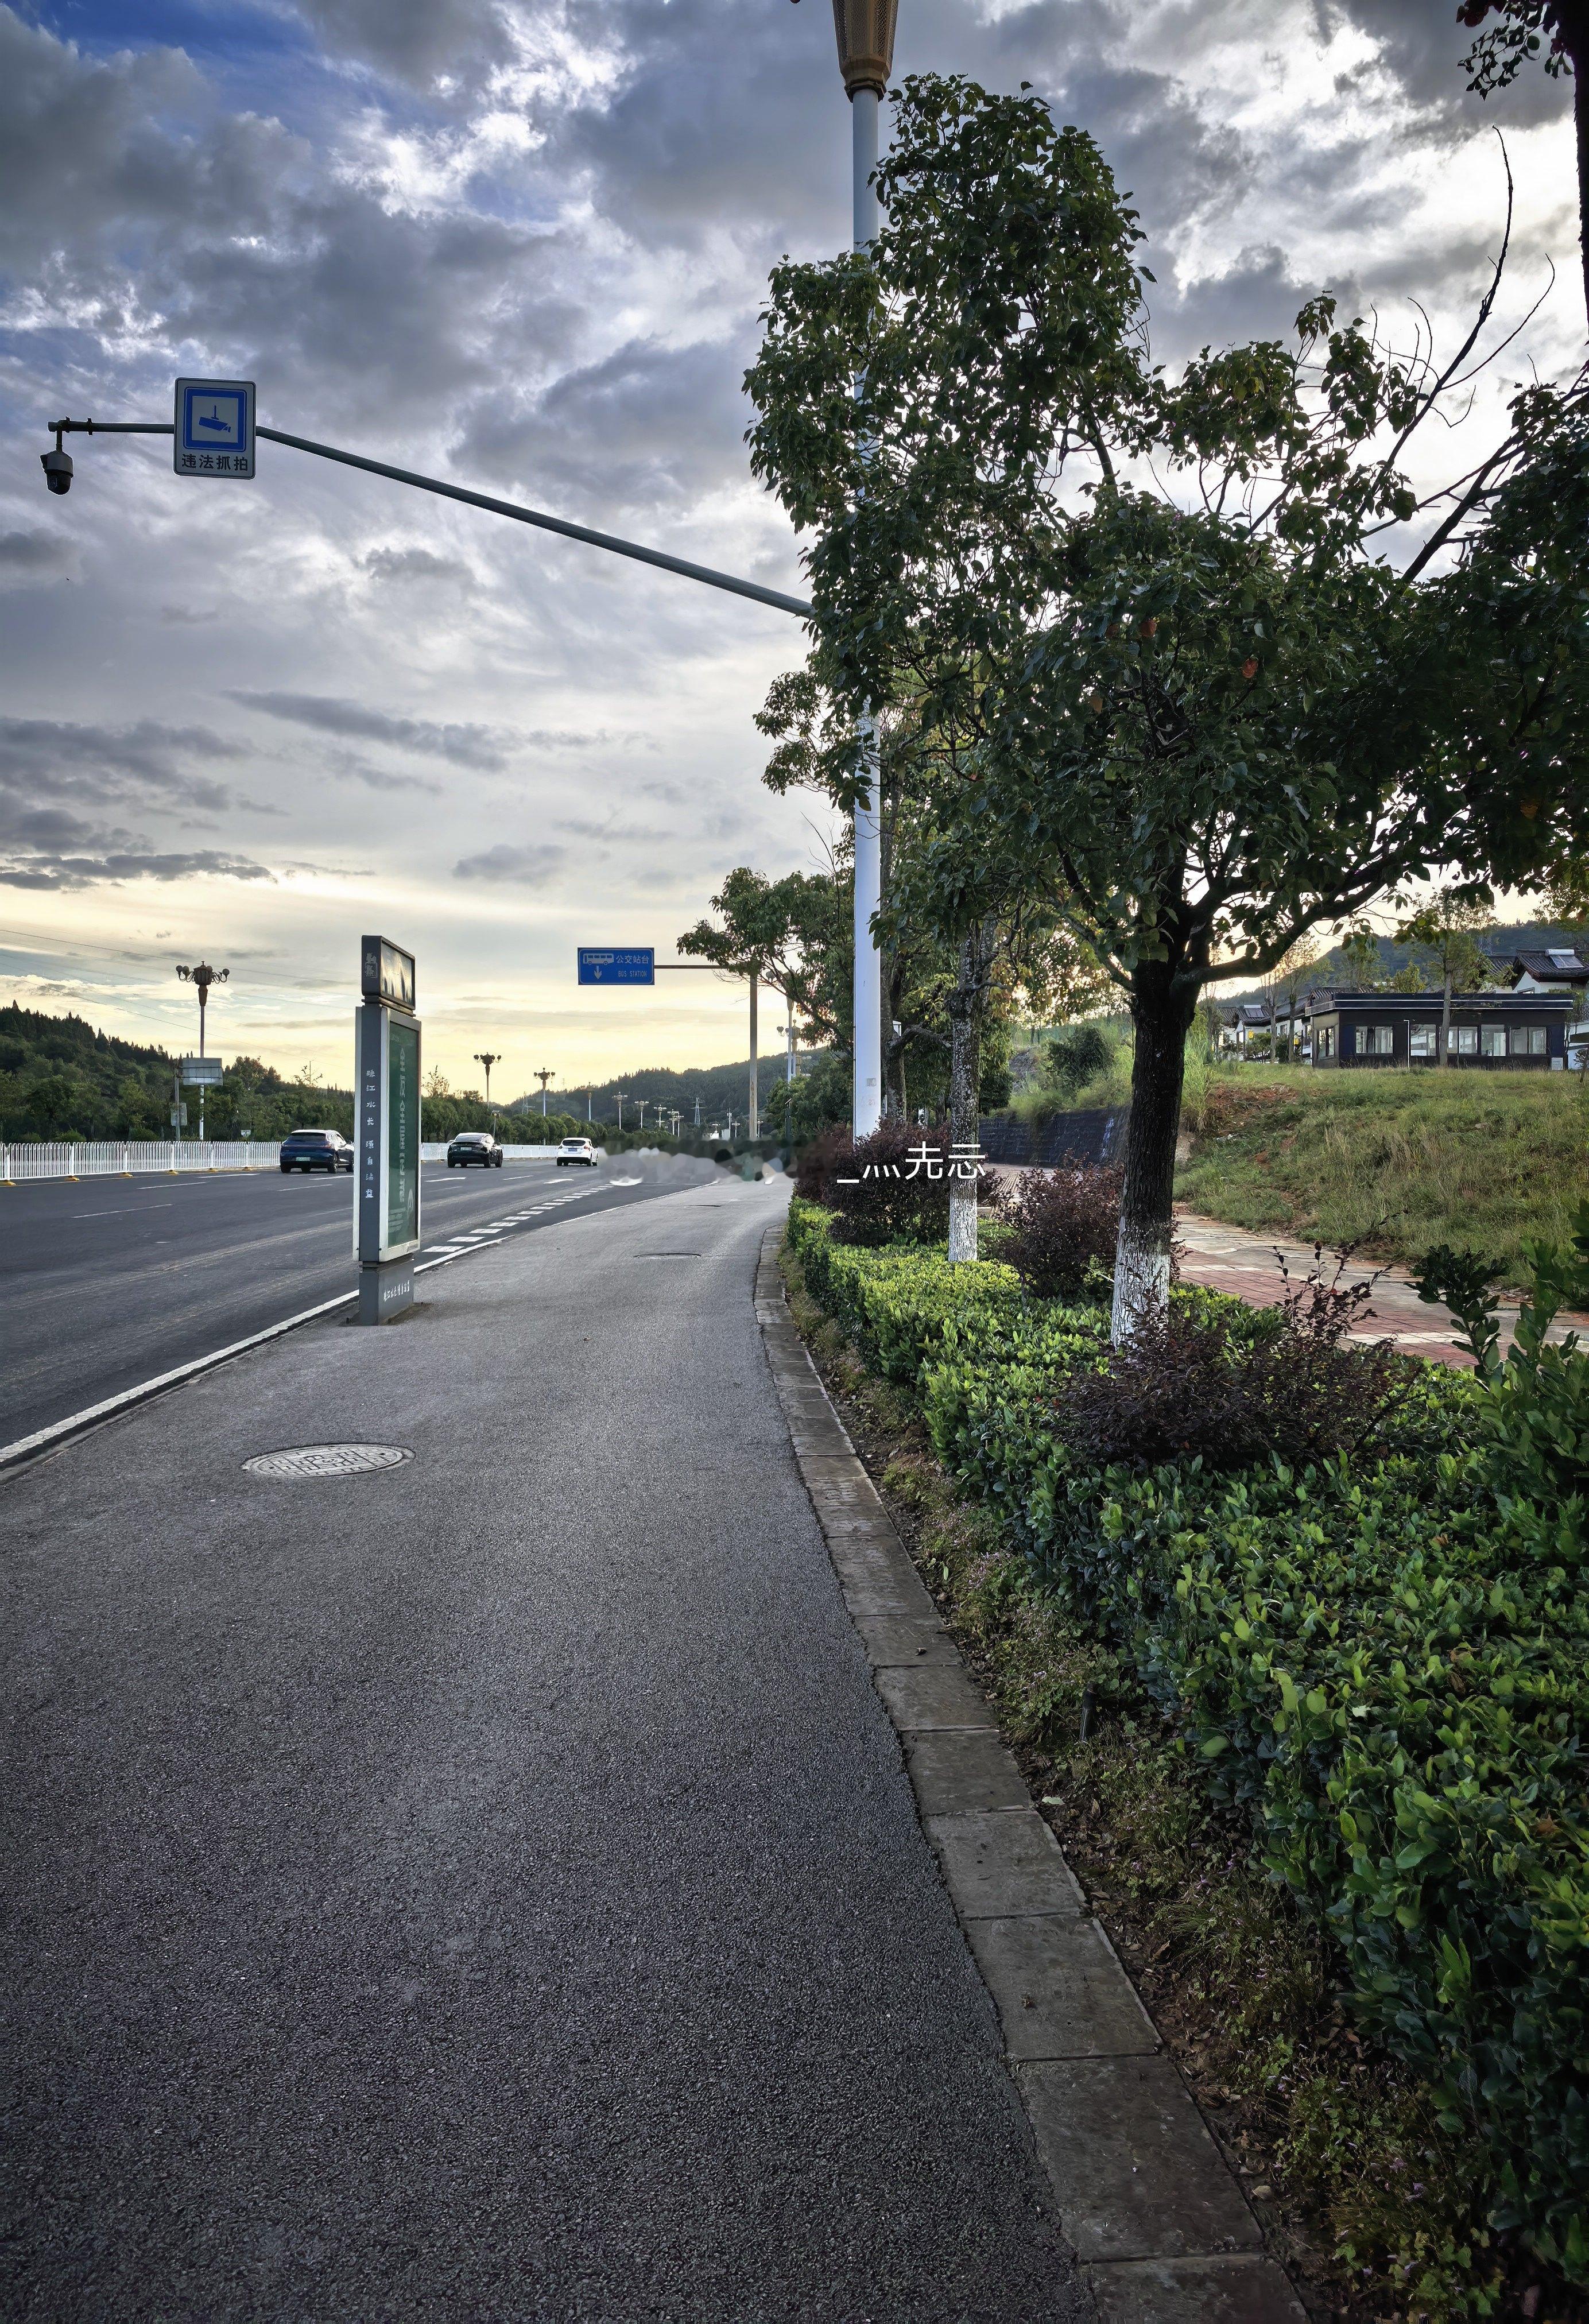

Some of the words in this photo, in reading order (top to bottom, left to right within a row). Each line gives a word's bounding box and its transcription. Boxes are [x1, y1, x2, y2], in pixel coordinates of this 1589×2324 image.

[181, 454, 249, 471] 违法抓拍
[615, 954, 650, 965] 公交站台
